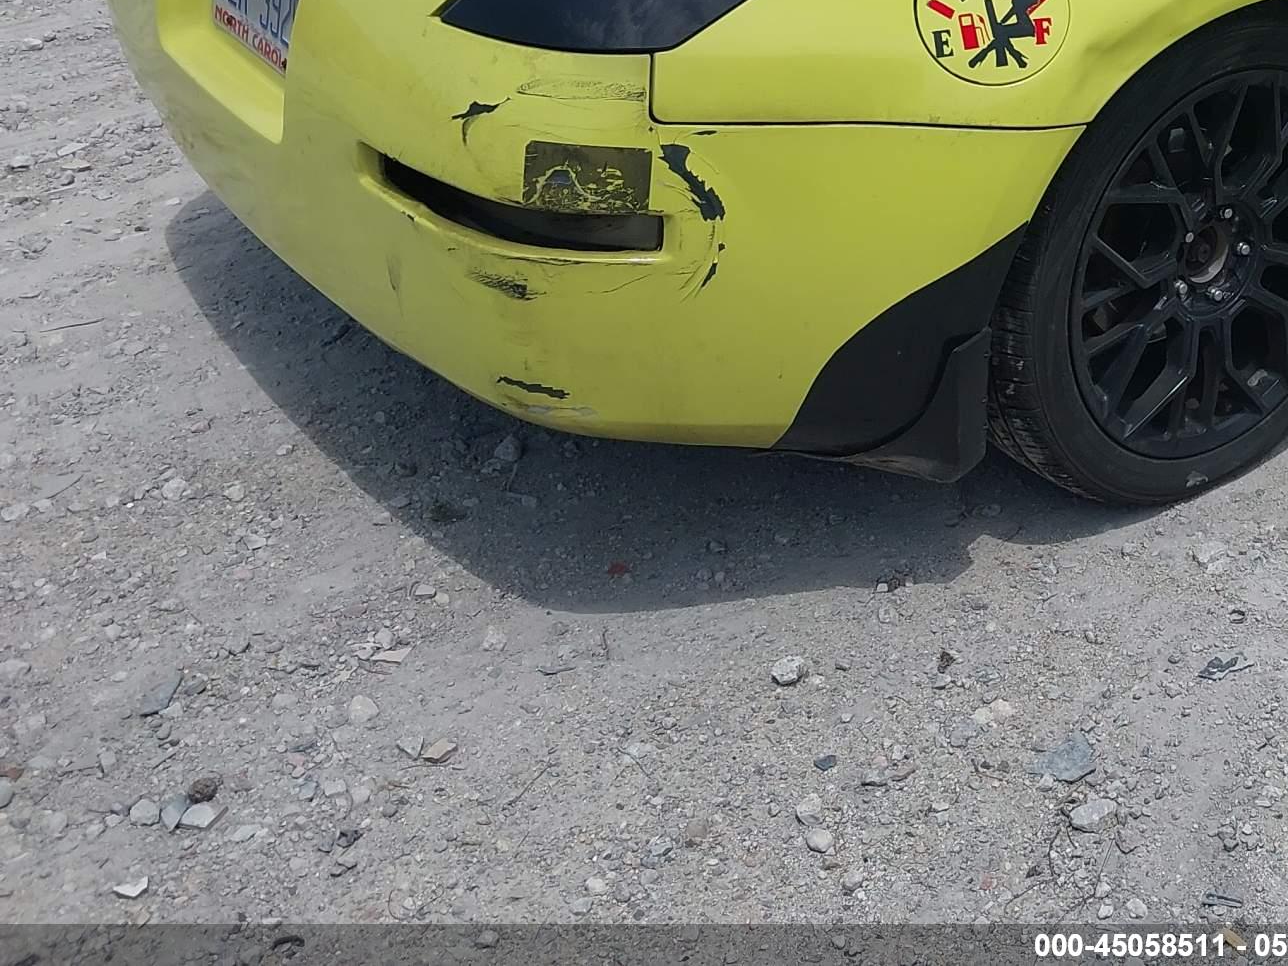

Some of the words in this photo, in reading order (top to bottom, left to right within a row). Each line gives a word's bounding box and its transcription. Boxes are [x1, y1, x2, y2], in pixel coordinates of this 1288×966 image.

[215, 4, 249, 43] NORTH
[1033, 17, 1052, 45] F
[931, 29, 954, 58] E
